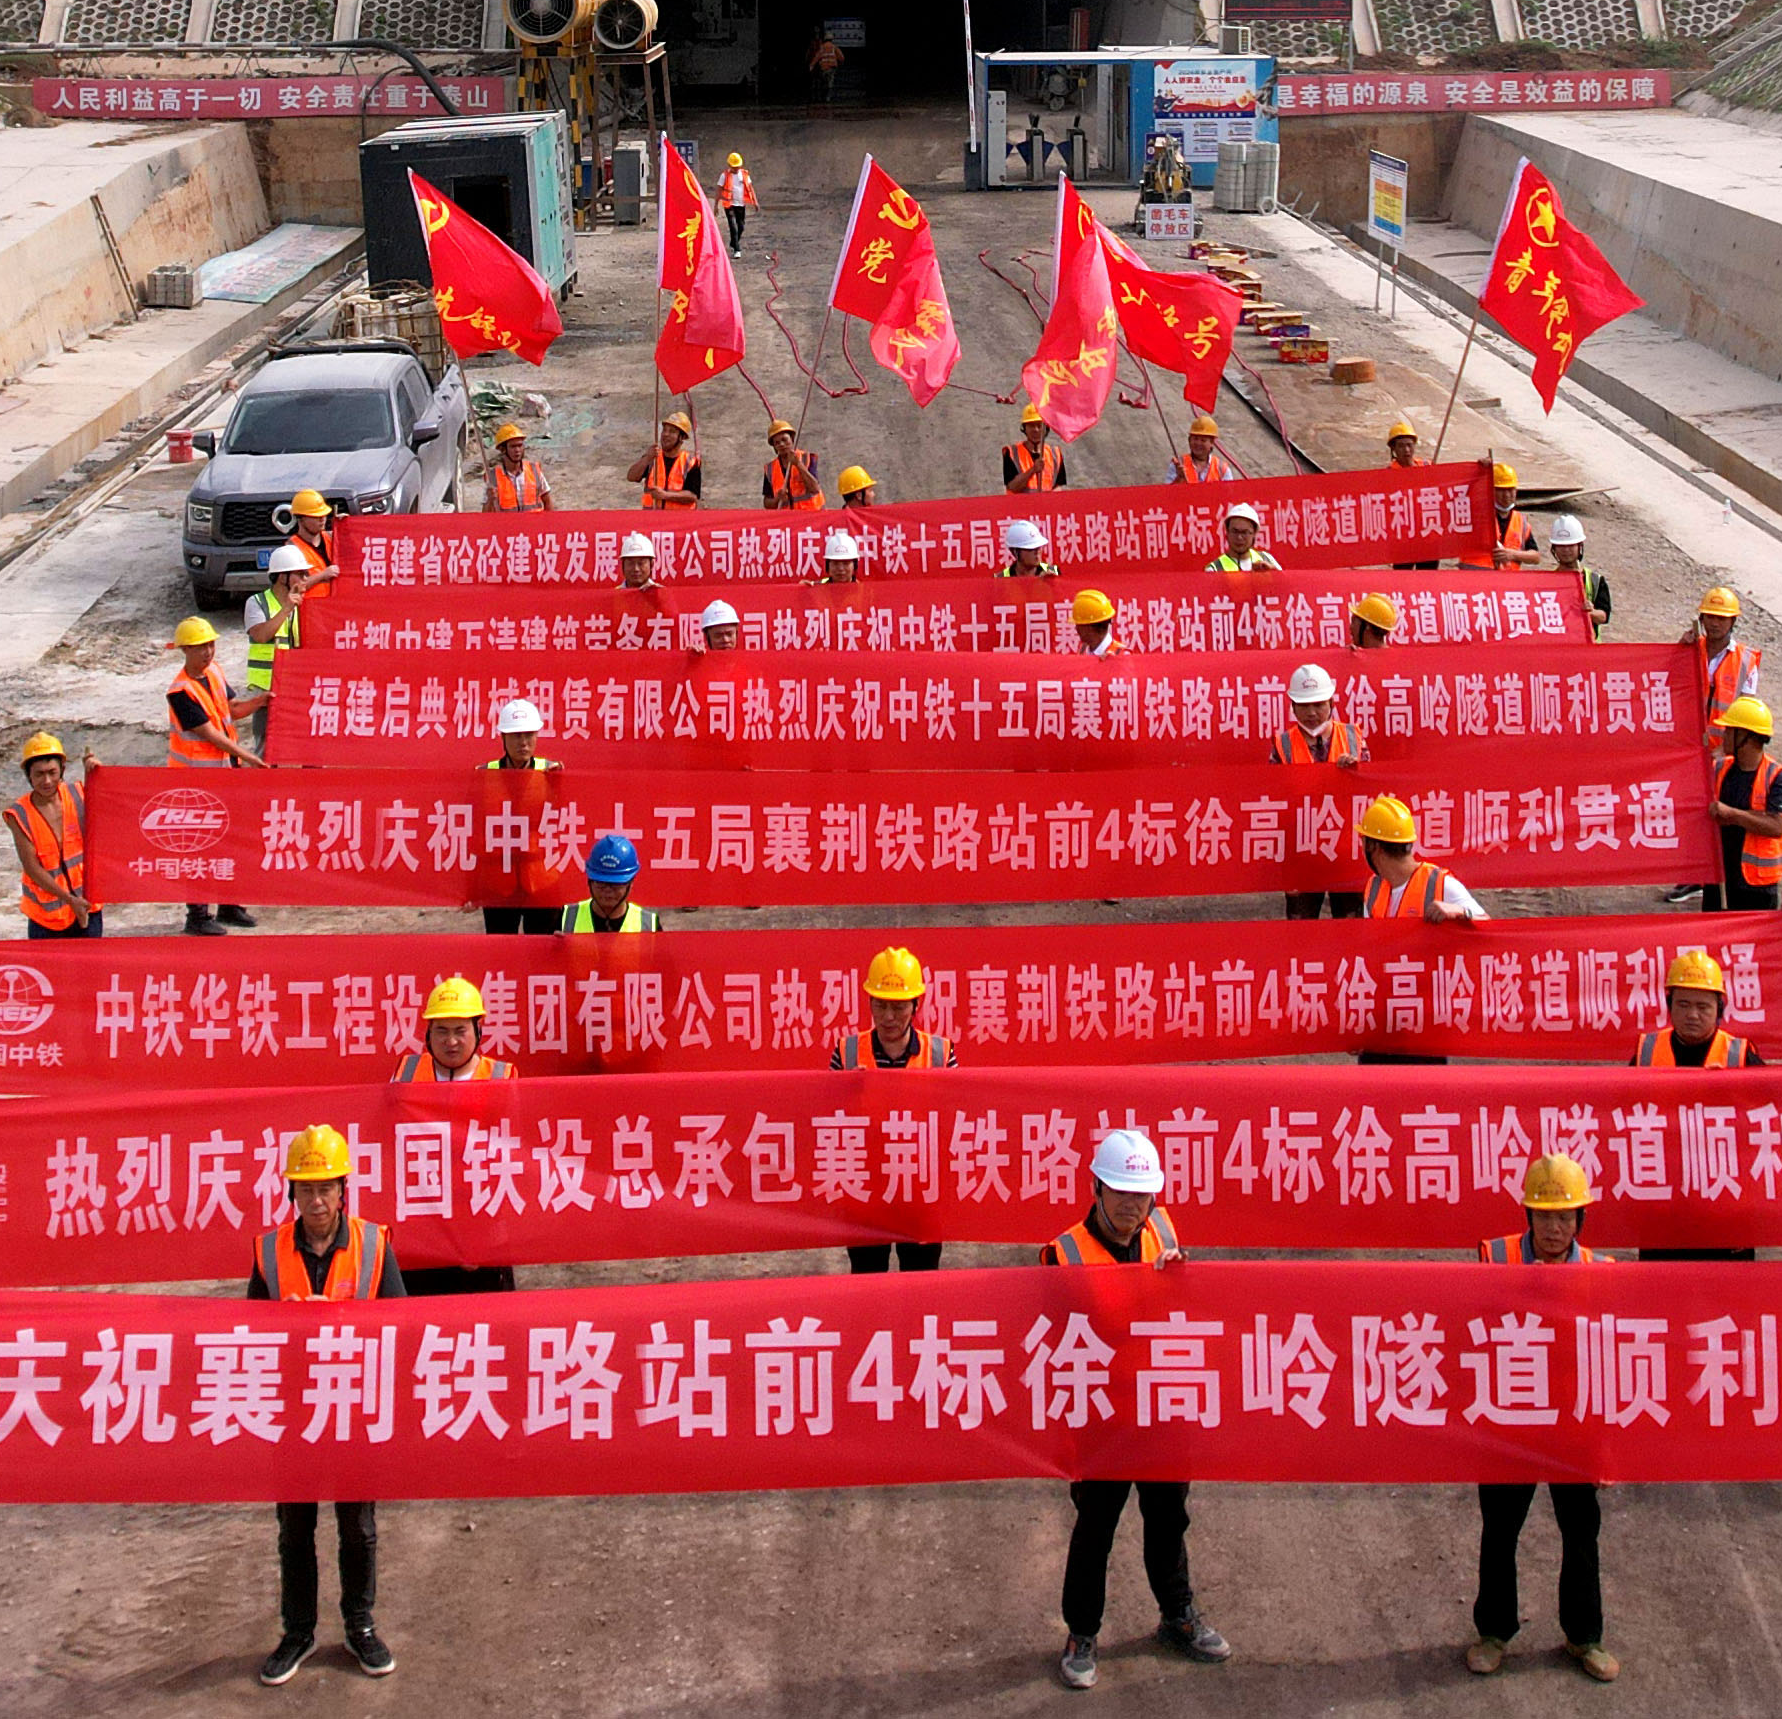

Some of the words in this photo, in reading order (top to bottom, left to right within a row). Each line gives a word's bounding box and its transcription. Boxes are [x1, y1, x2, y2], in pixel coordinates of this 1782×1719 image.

[52, 86, 261, 111] 人民利益高于一切
[279, 84, 489, 109] 安全责任重于泰山
[1277, 81, 1429, 109] 是幸福的源泉
[1445, 75, 1656, 105] 安全是效益的保障
[857, 237, 895, 284] 党
[129, 857, 235, 881] 中国铁建
[95, 943, 1766, 1058] 中铁华铁工程设集团有限公司热烈祝襄荆铁路站前4标徐高岭隧道顺利通
